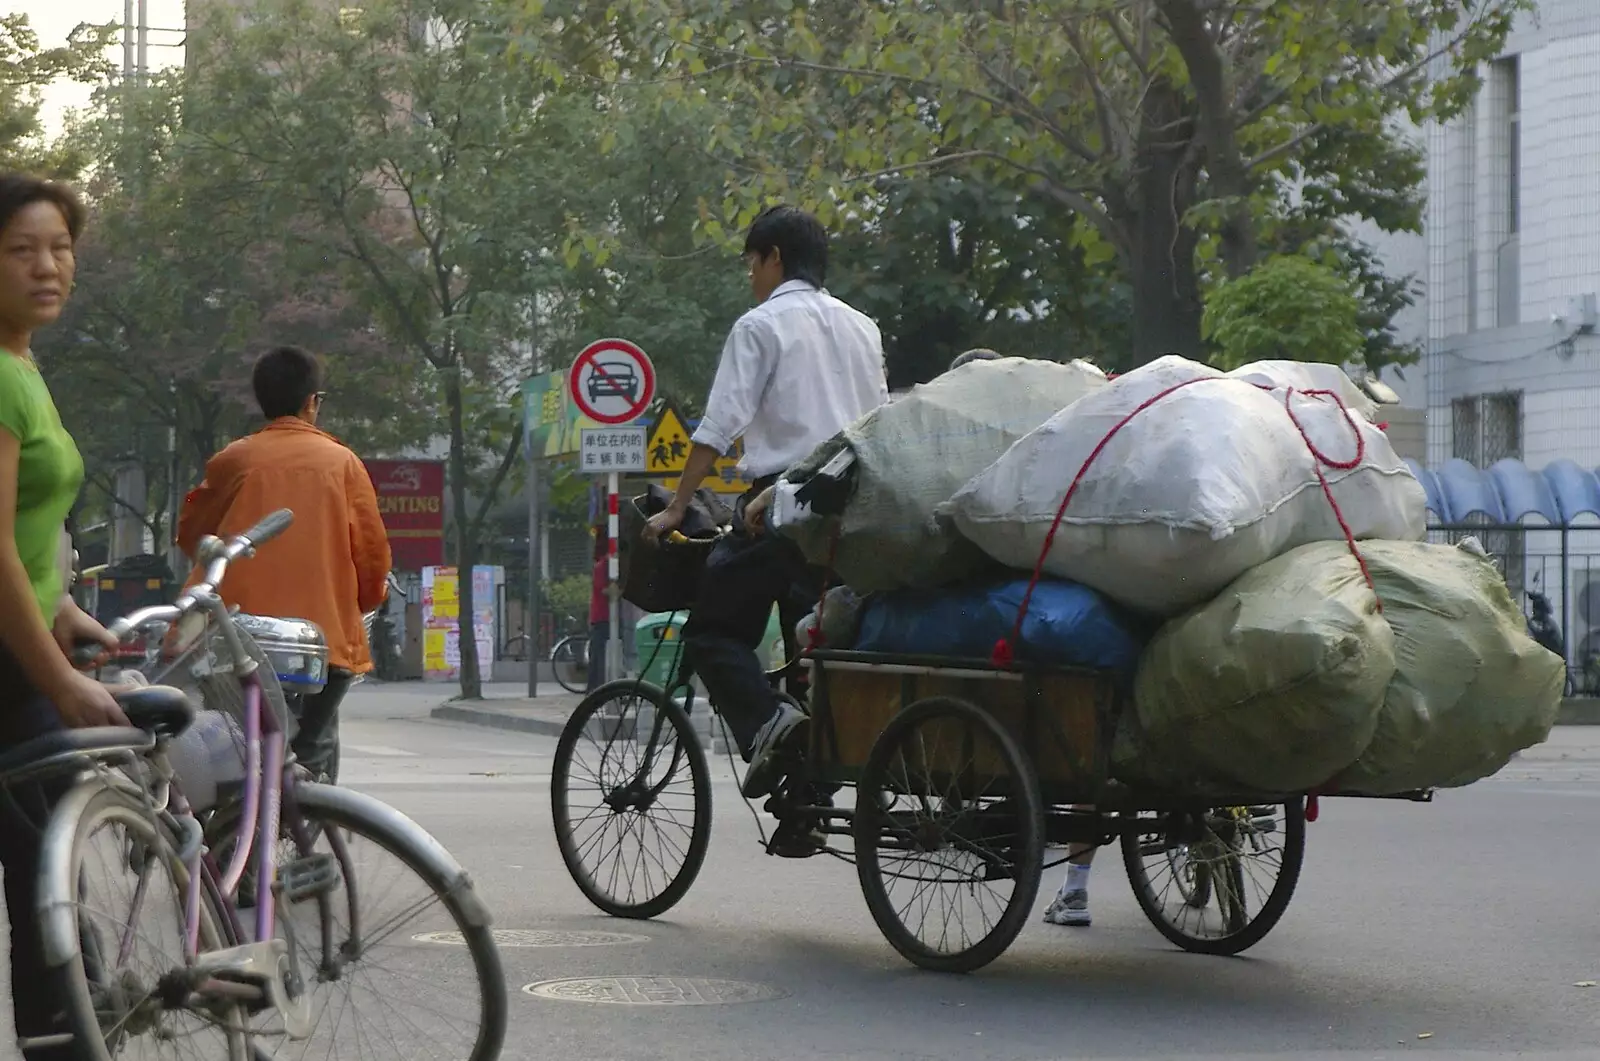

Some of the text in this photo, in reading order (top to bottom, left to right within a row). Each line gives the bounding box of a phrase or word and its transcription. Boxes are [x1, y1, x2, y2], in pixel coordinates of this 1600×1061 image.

[585, 433, 642, 447] 单位在内的
[585, 451, 642, 466] 车辆除外
